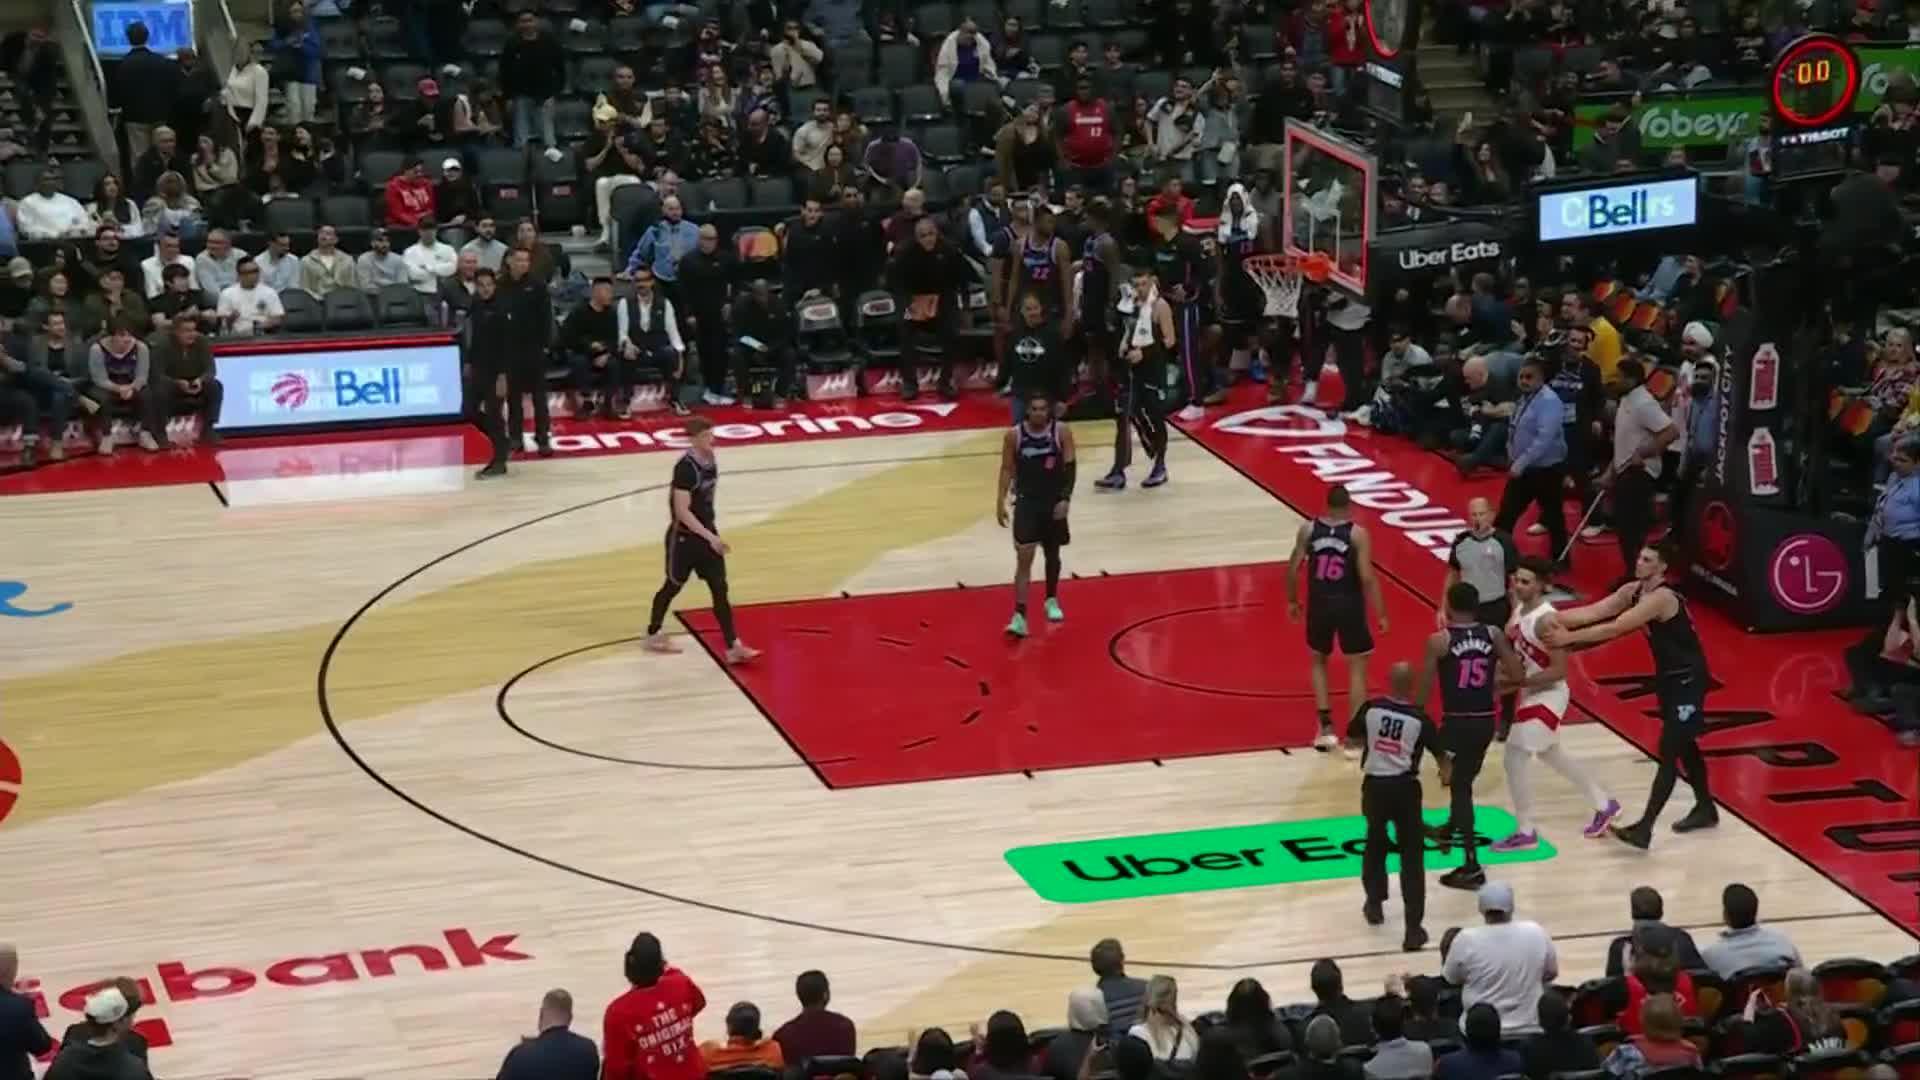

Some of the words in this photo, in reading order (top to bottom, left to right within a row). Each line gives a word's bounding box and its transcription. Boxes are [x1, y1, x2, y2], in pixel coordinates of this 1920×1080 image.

[1588, 190, 1648, 229] Bell
[1399, 250, 1447, 270] Uber
[1451, 241, 1499, 263] Eats
[334, 368, 400, 406] Bell
[1277, 442, 1468, 562] FANDUE
[1315, 554, 1345, 581] 16
[1457, 657, 1489, 689] 15
[1593, 674, 1920, 900] RAPTO
[1062, 847, 1265, 882] Uber
[652, 1007, 678, 1027] THE
